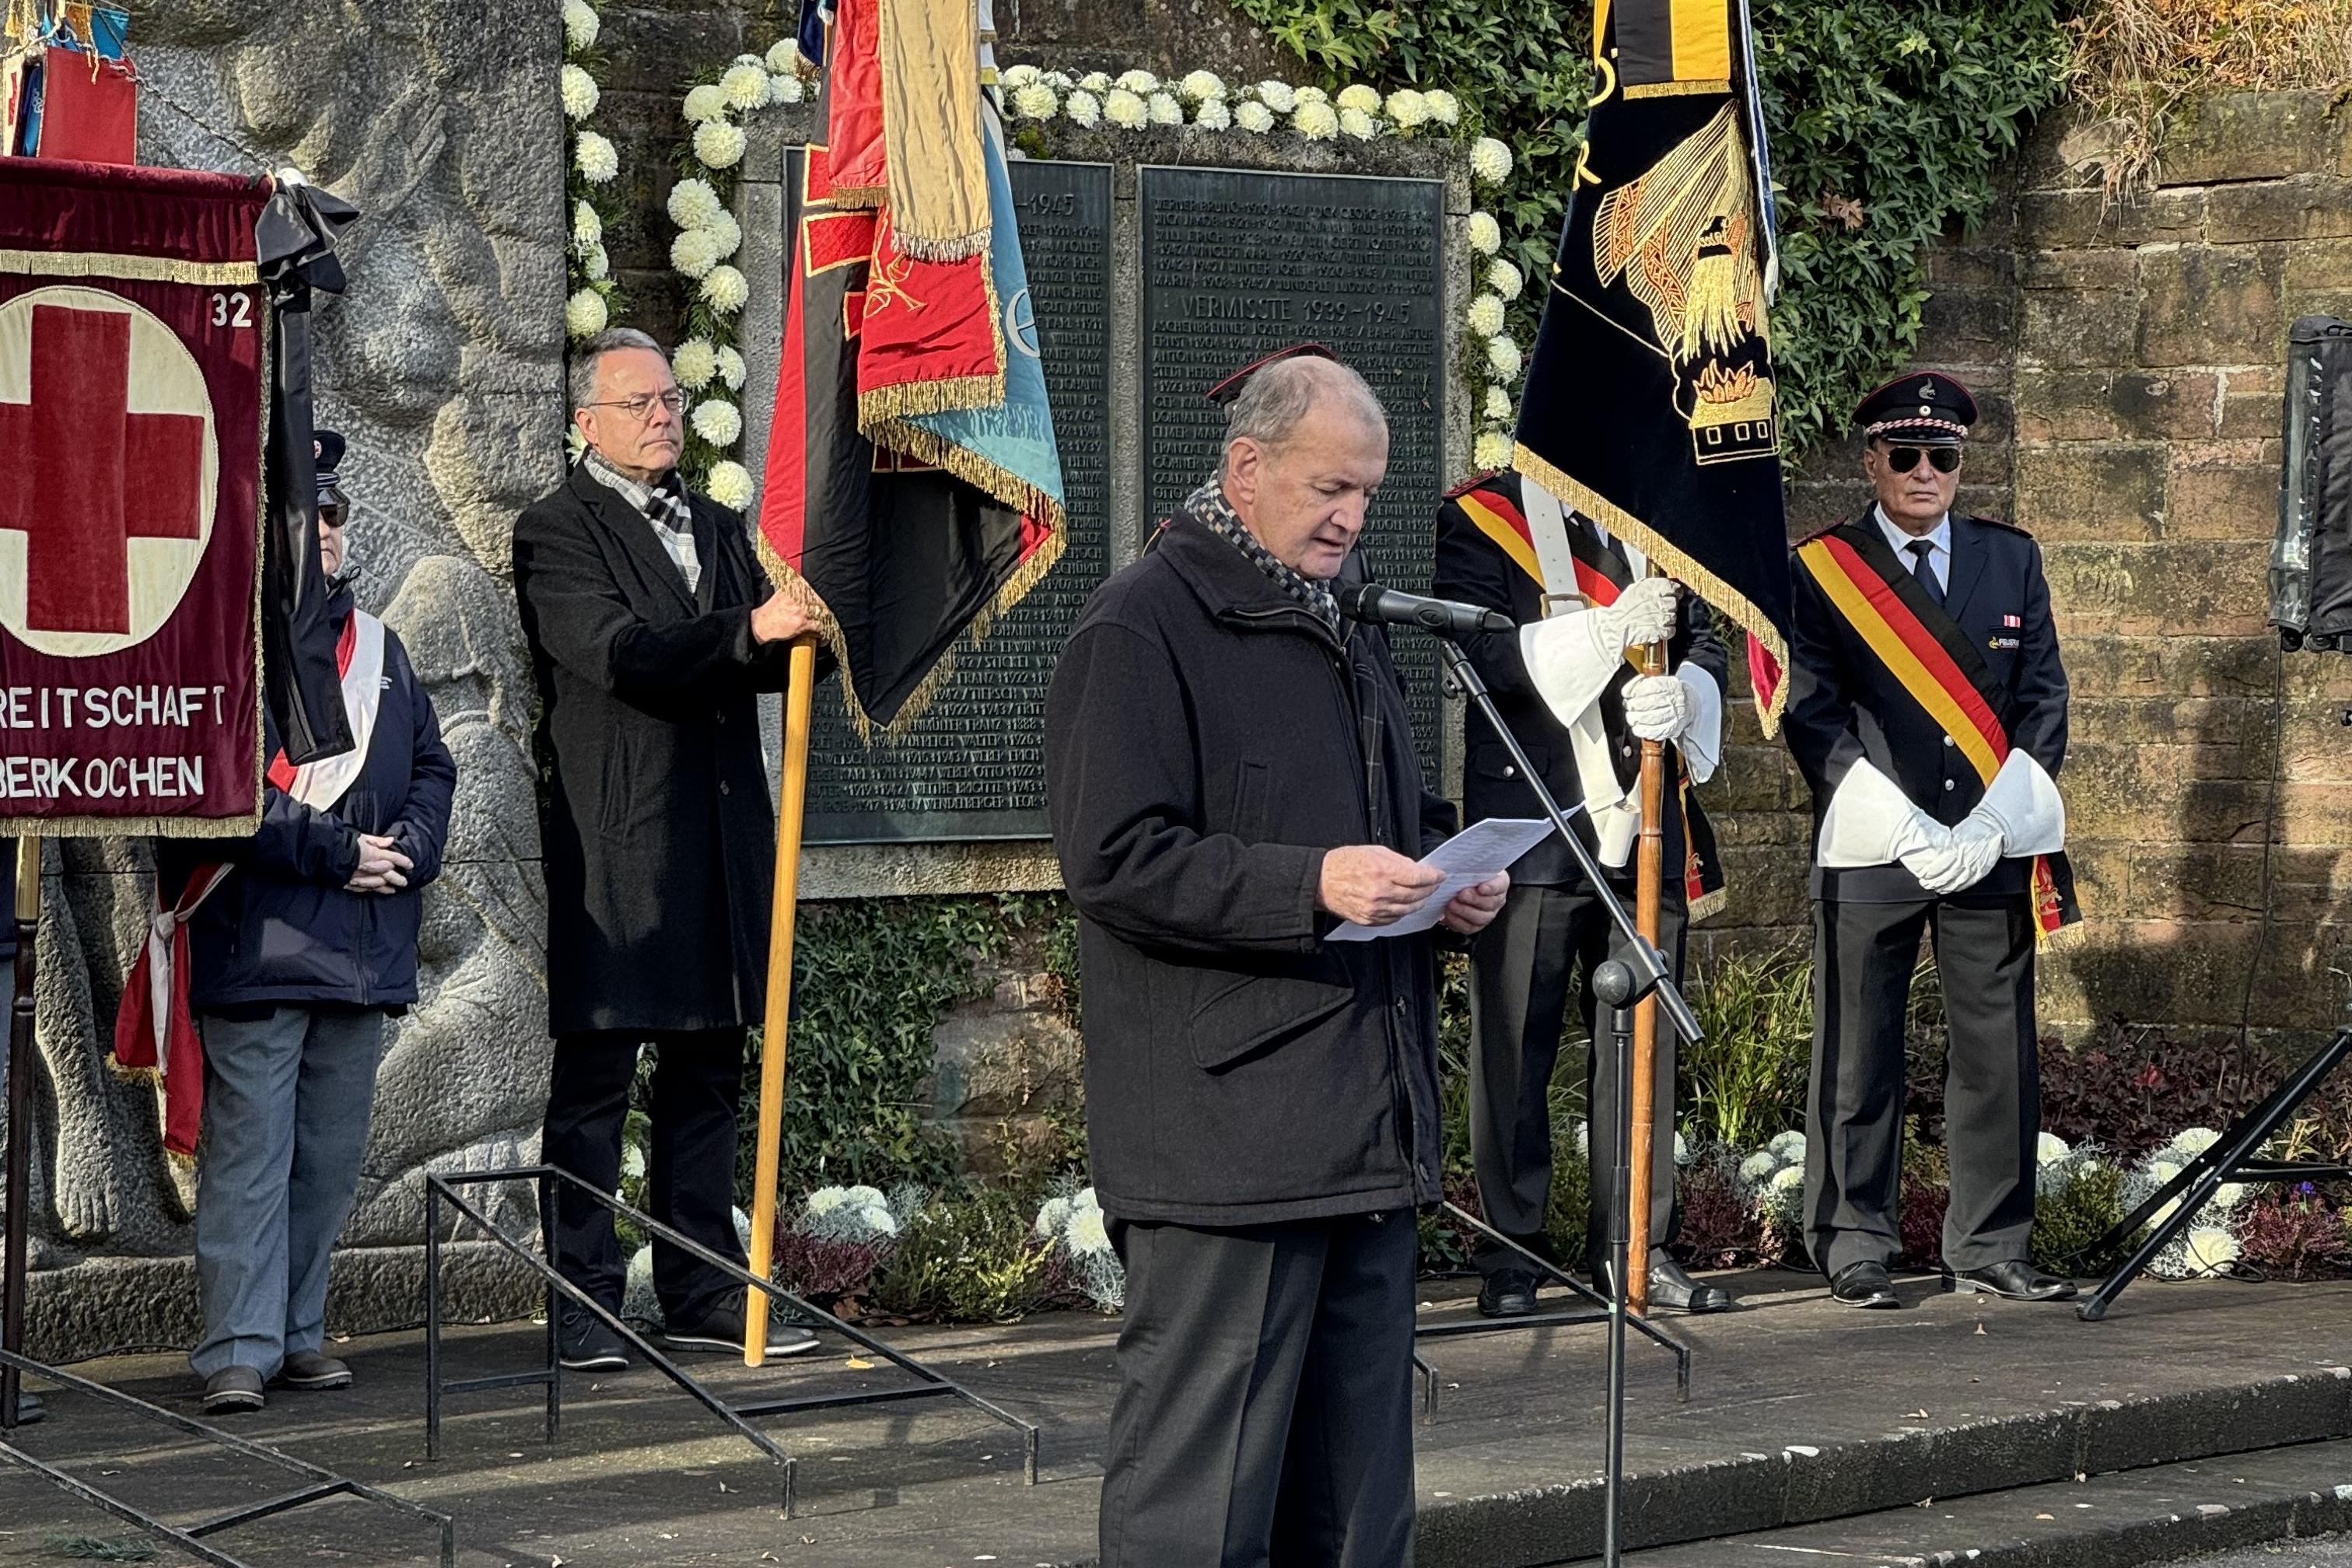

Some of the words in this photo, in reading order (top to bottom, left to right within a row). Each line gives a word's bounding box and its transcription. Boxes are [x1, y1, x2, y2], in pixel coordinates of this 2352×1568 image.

[212, 292, 251, 327] 32
[1181, 296, 1292, 322] VERMISSTE
[1153, 486, 1184, 499] OTTO
[968, 686, 1017, 701] TIERSCH
[958, 734, 999, 747] WALTER
[973, 765, 1005, 778] OTTO
